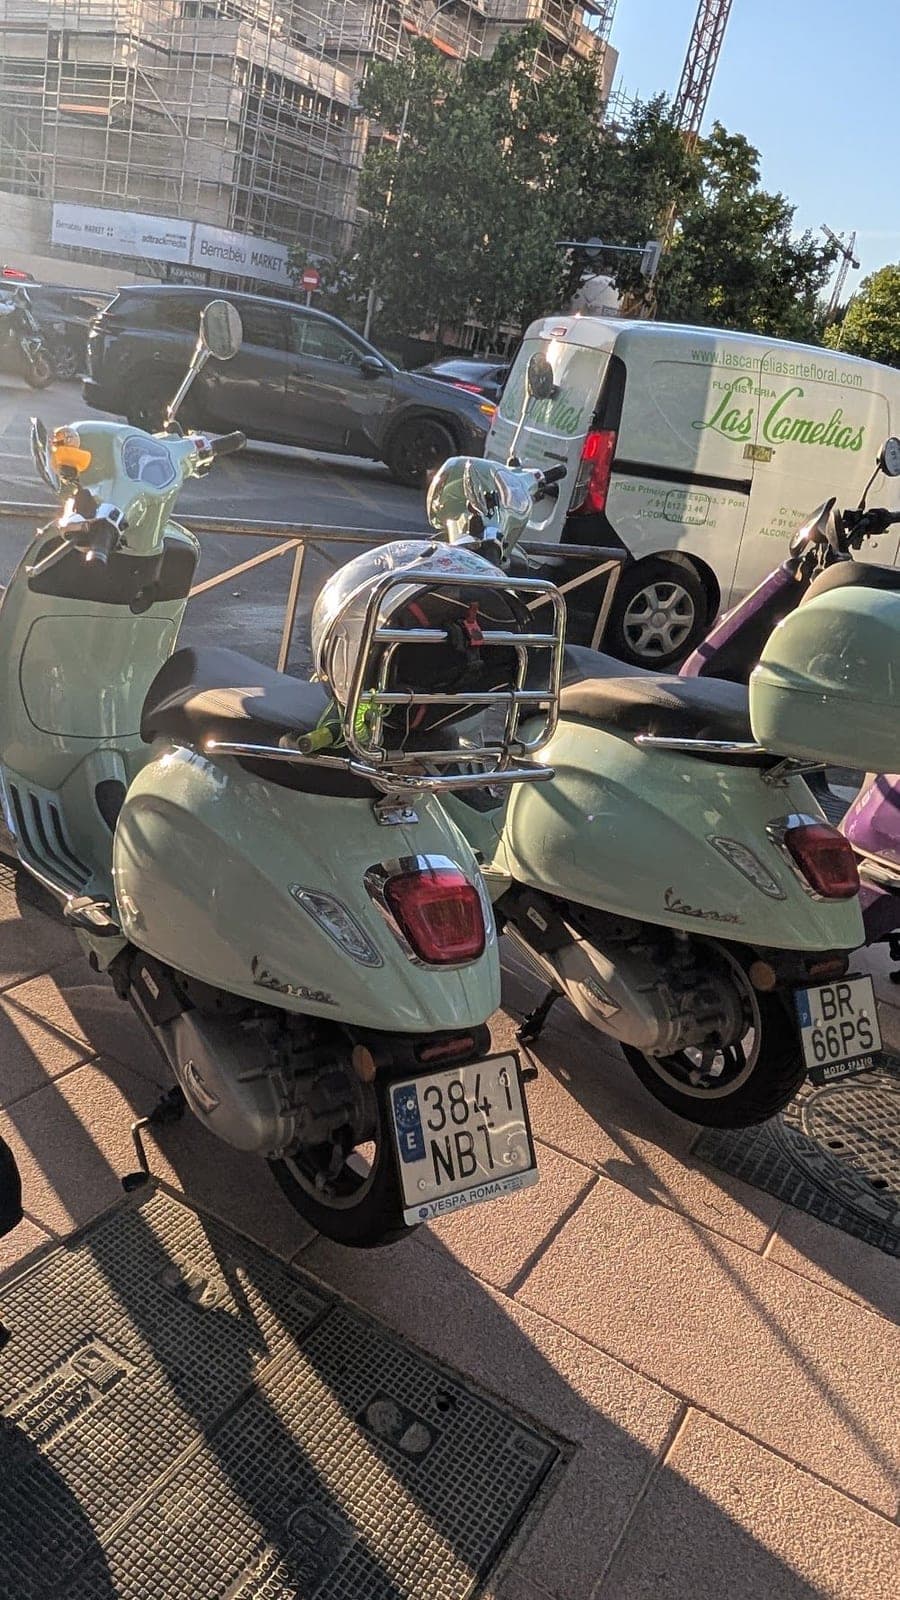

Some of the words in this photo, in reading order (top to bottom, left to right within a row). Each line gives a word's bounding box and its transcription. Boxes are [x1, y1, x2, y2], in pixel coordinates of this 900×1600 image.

[250, 251, 284, 273] MARKET
[691, 350, 863, 387] www.lascameliasartefloral.com
[691, 376, 754, 442] Las
[762, 386, 866, 452] Camelias
[819, 983, 855, 1022] BR
[811, 1016, 874, 1062] 66PS
[823, 1064, 846, 1075] MOTO
[847, 1057, 873, 1069] SPAZIO
[423, 1067, 513, 1132] 3841
[406, 1131, 418, 1150] E
[429, 1121, 495, 1186] NBT
[430, 1193, 467, 1213] VESPA
[469, 1182, 502, 1201] ROMA
